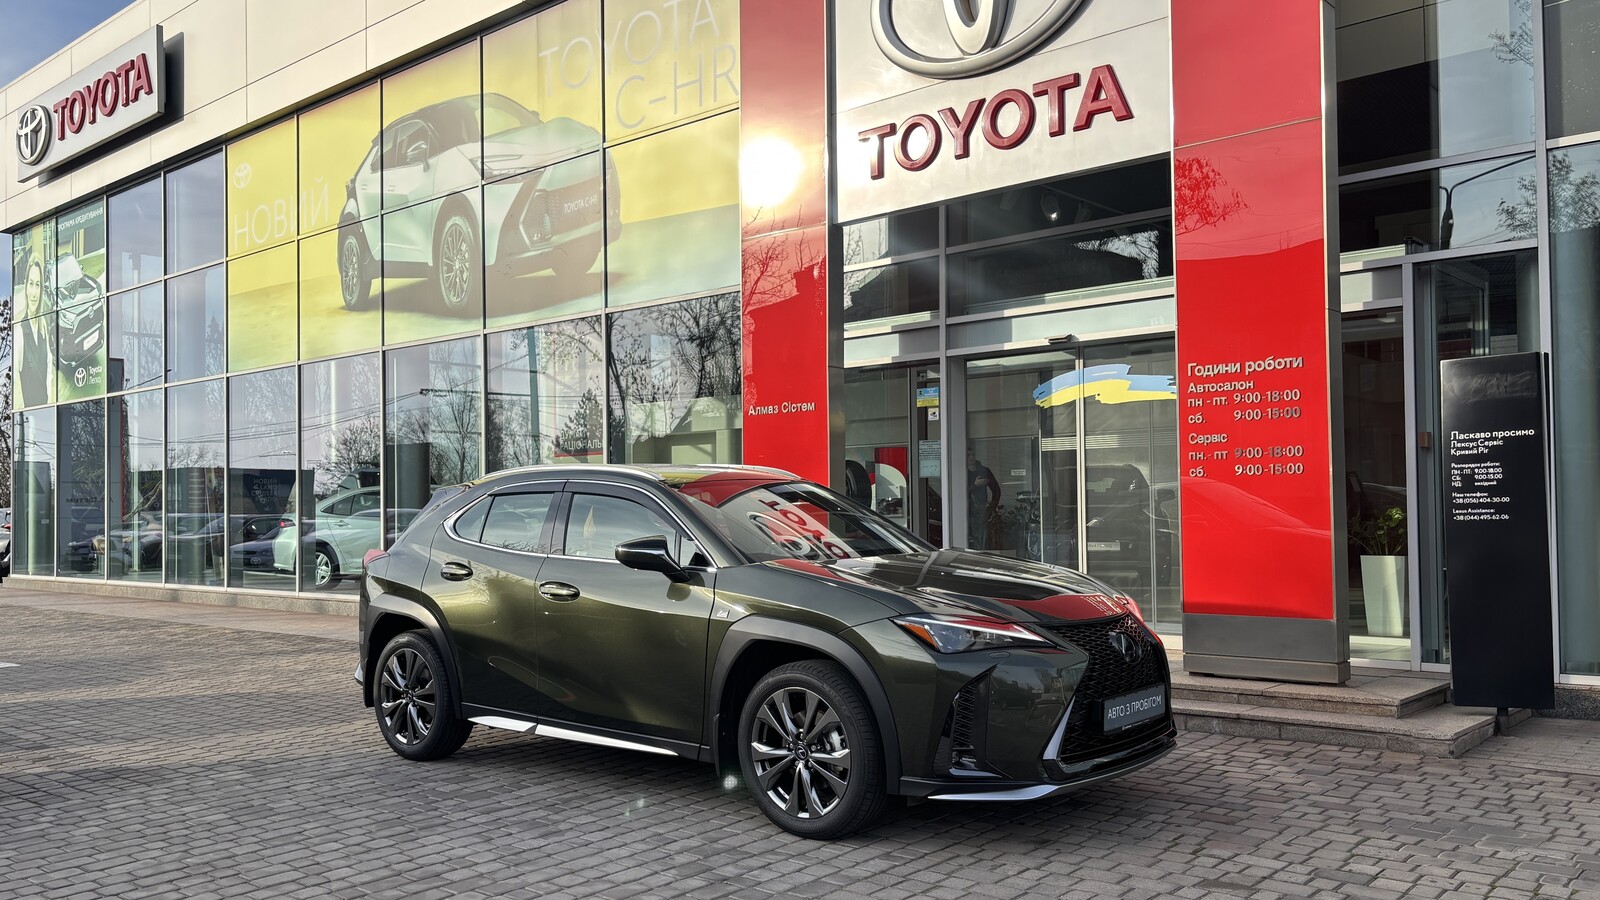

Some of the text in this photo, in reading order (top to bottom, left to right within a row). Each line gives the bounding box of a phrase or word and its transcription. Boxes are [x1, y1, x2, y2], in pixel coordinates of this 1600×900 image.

[538, 0, 720, 97] TOYOTA
[615, 44, 739, 129] C-HR
[53, 52, 154, 141] TOYOTA
[858, 64, 1134, 180] TOYOTA
[233, 176, 329, 252] НОВИЙ
[1187, 356, 1303, 378] Години роботи
[1187, 380, 1255, 393] Автосалон
[1233, 389, 1301, 404] 9:00-18:00
[748, 401, 816, 416] Алмаз Сістем
[1188, 406, 1301, 424] сб. 9:00-15:00
[1188, 433, 1228, 446] Сервіс
[1450, 429, 1535, 440] Ласкаво просимо
[1450, 439, 1504, 448] Лексус Сервіс
[1234, 446, 1303, 459] 9:00-18:00
[1450, 448, 1477, 456] Кривий
[1189, 463, 1304, 477] сб. 9:00-15:00
[1107, 705, 1125, 720] АВТО
[1131, 694, 1162, 713] ПРОБІГОМ
